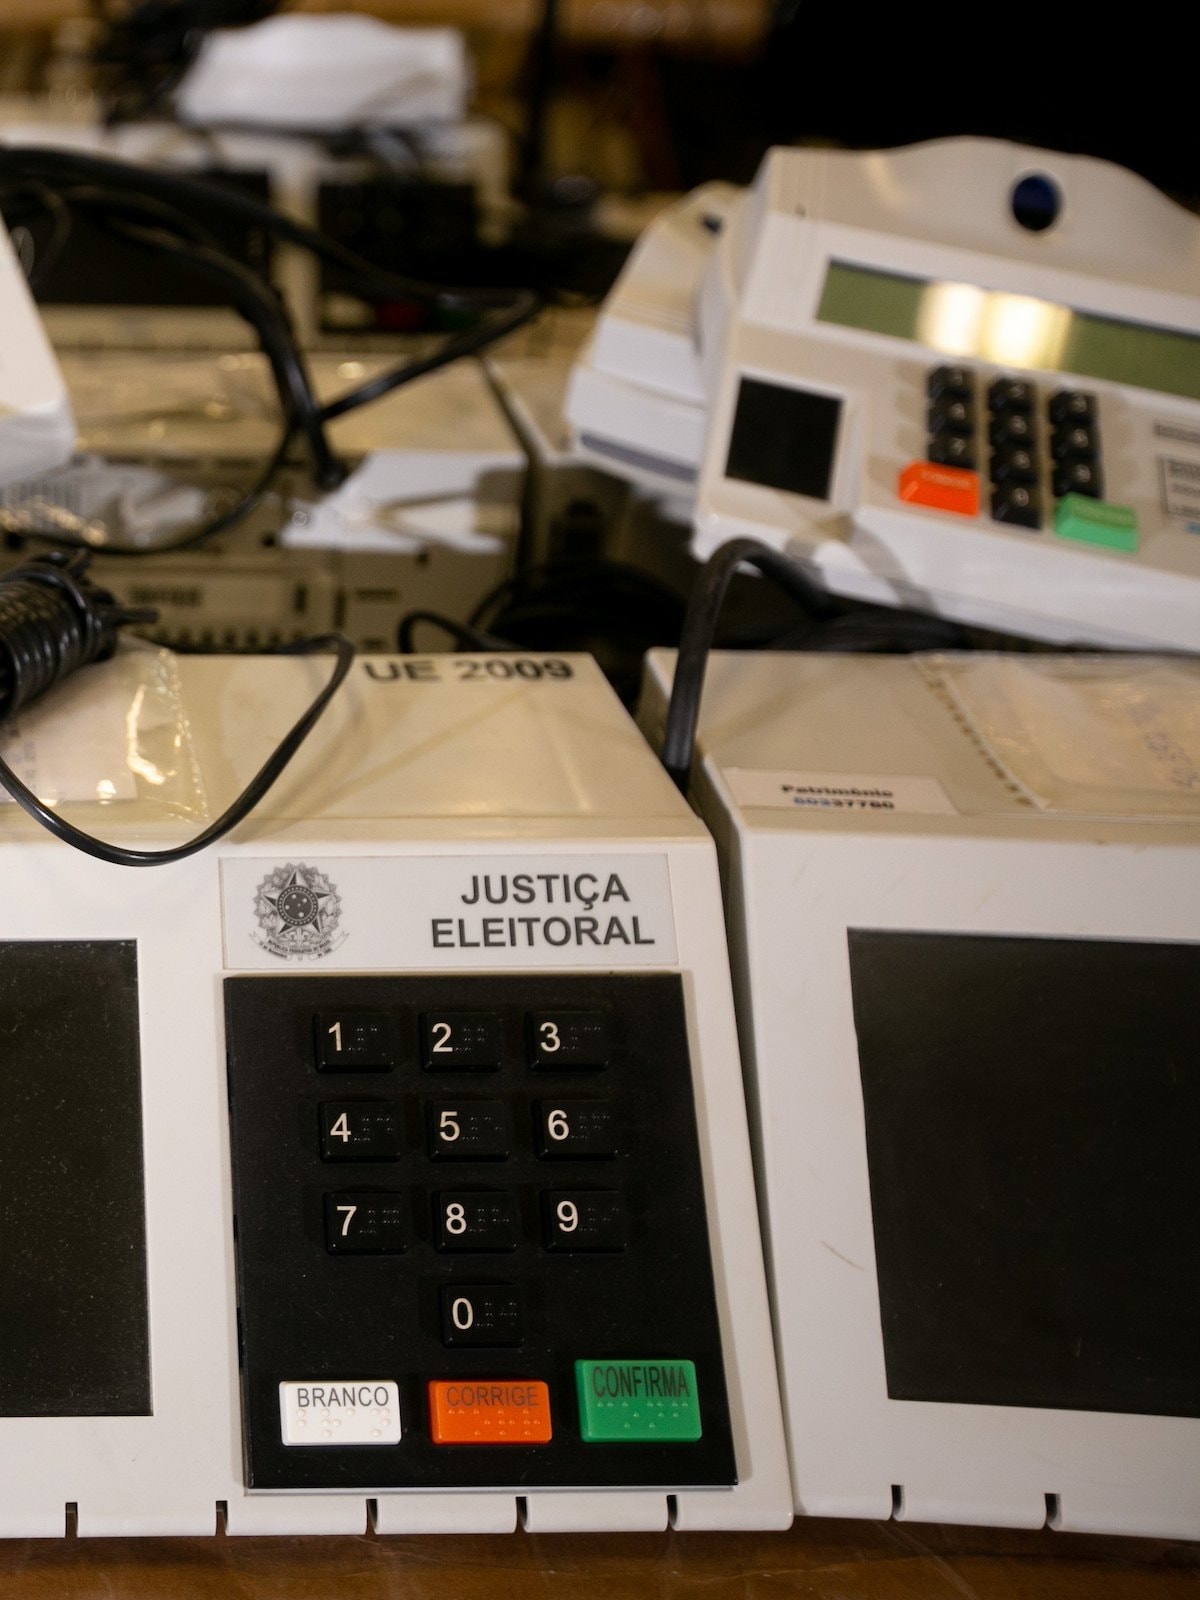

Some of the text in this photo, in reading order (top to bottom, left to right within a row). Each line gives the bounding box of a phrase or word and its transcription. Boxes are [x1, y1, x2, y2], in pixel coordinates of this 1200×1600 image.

[362, 659, 573, 682] UE 2009
[462, 874, 629, 910] JUSTIÇA
[432, 917, 654, 947] ELEITORAL
[329, 1023, 341, 1051] 1
[433, 1023, 452, 1052] 2
[541, 1022, 560, 1051] 3
[331, 1113, 351, 1142] 4
[441, 1112, 459, 1141] 5
[549, 1110, 569, 1140] 6
[337, 1206, 356, 1235] 7
[446, 1204, 466, 1234] 8
[557, 1201, 578, 1231] 9
[453, 1298, 473, 1329] 0
[592, 1365, 688, 1398] CONFIRMA
[298, 1387, 388, 1407] BRANCO
[447, 1386, 539, 1407] CORRIGE
